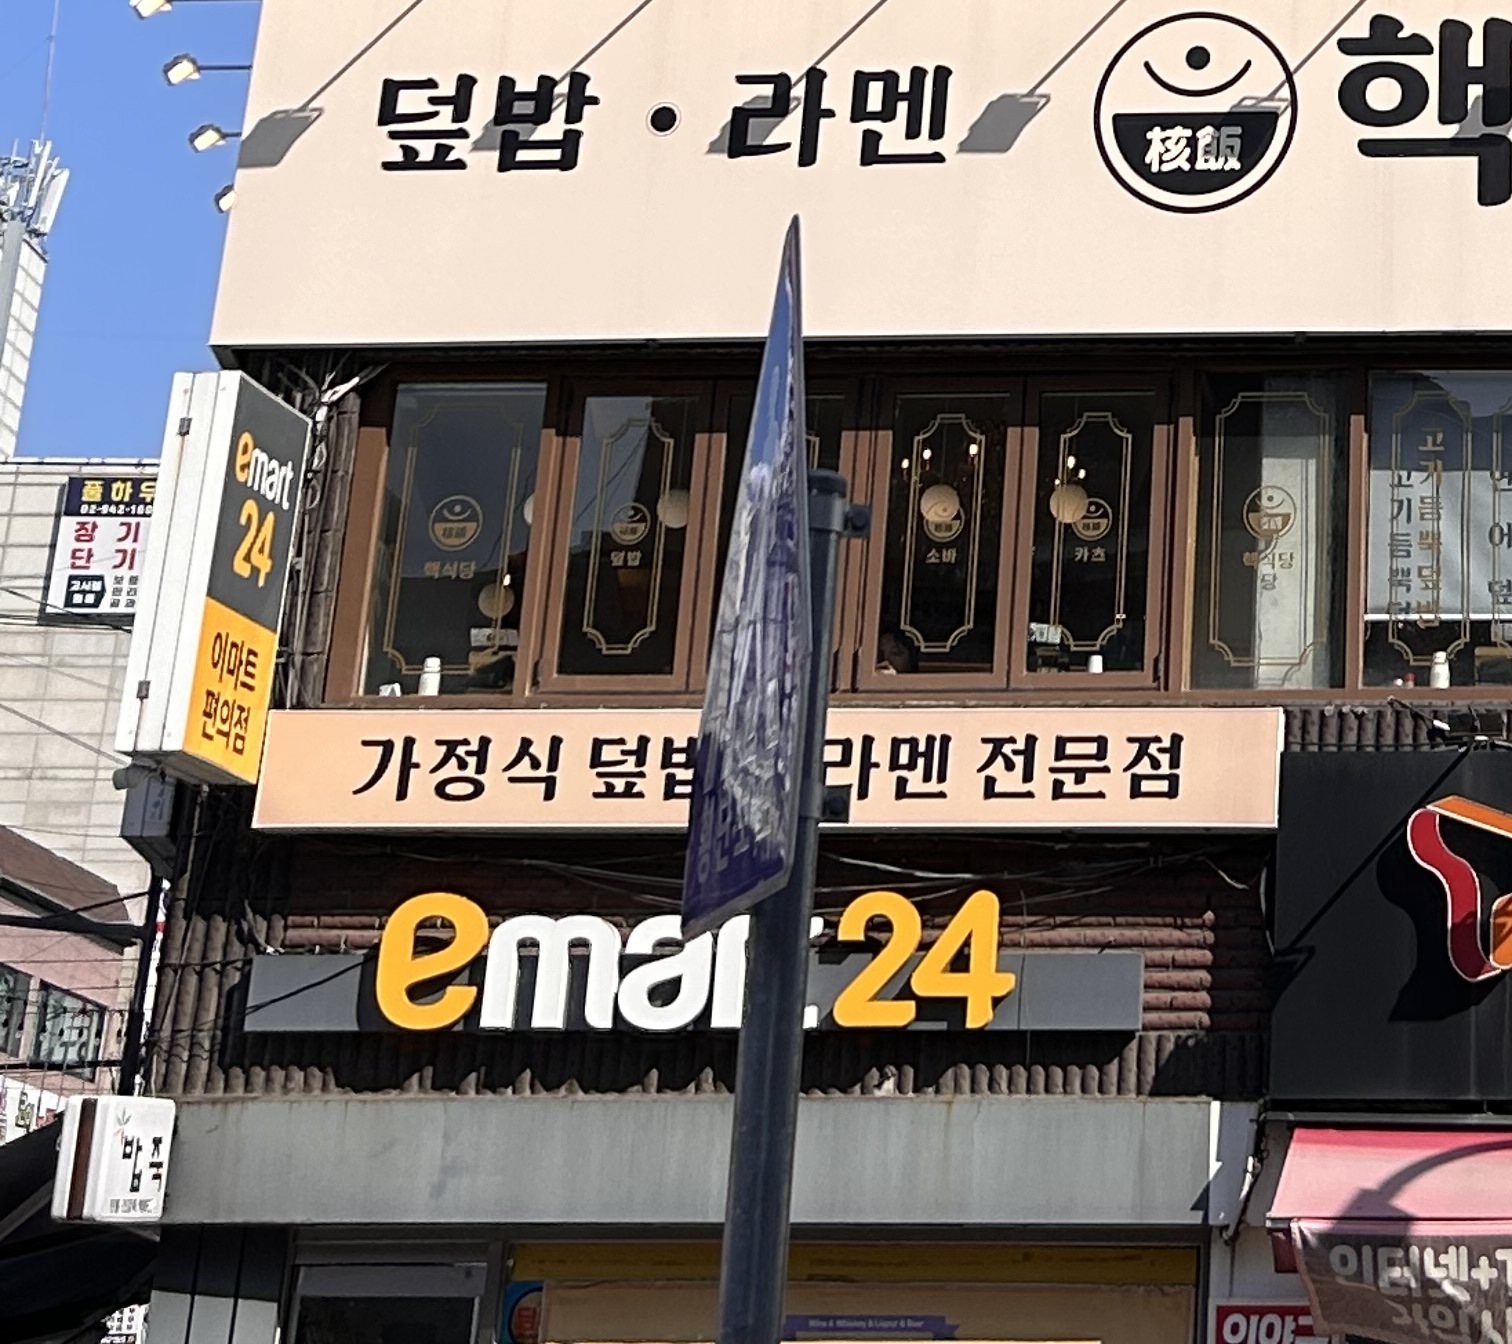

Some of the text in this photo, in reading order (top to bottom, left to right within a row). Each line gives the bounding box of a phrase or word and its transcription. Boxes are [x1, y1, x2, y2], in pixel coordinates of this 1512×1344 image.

[377, 64, 954, 173] 덮밥 라멘
[1145, 125, 1243, 173] 核飯
[235, 431, 296, 511] emart
[232, 499, 275, 589] 24
[925, 546, 957, 564] 소바
[1073, 545, 1106, 563] 카츠
[211, 630, 260, 692] 이마트
[202, 687, 251, 756] 편의점
[351, 735, 564, 803] 가정식
[976, 731, 1186, 802] 전문점
[375, 888, 1016, 1032] emar24
